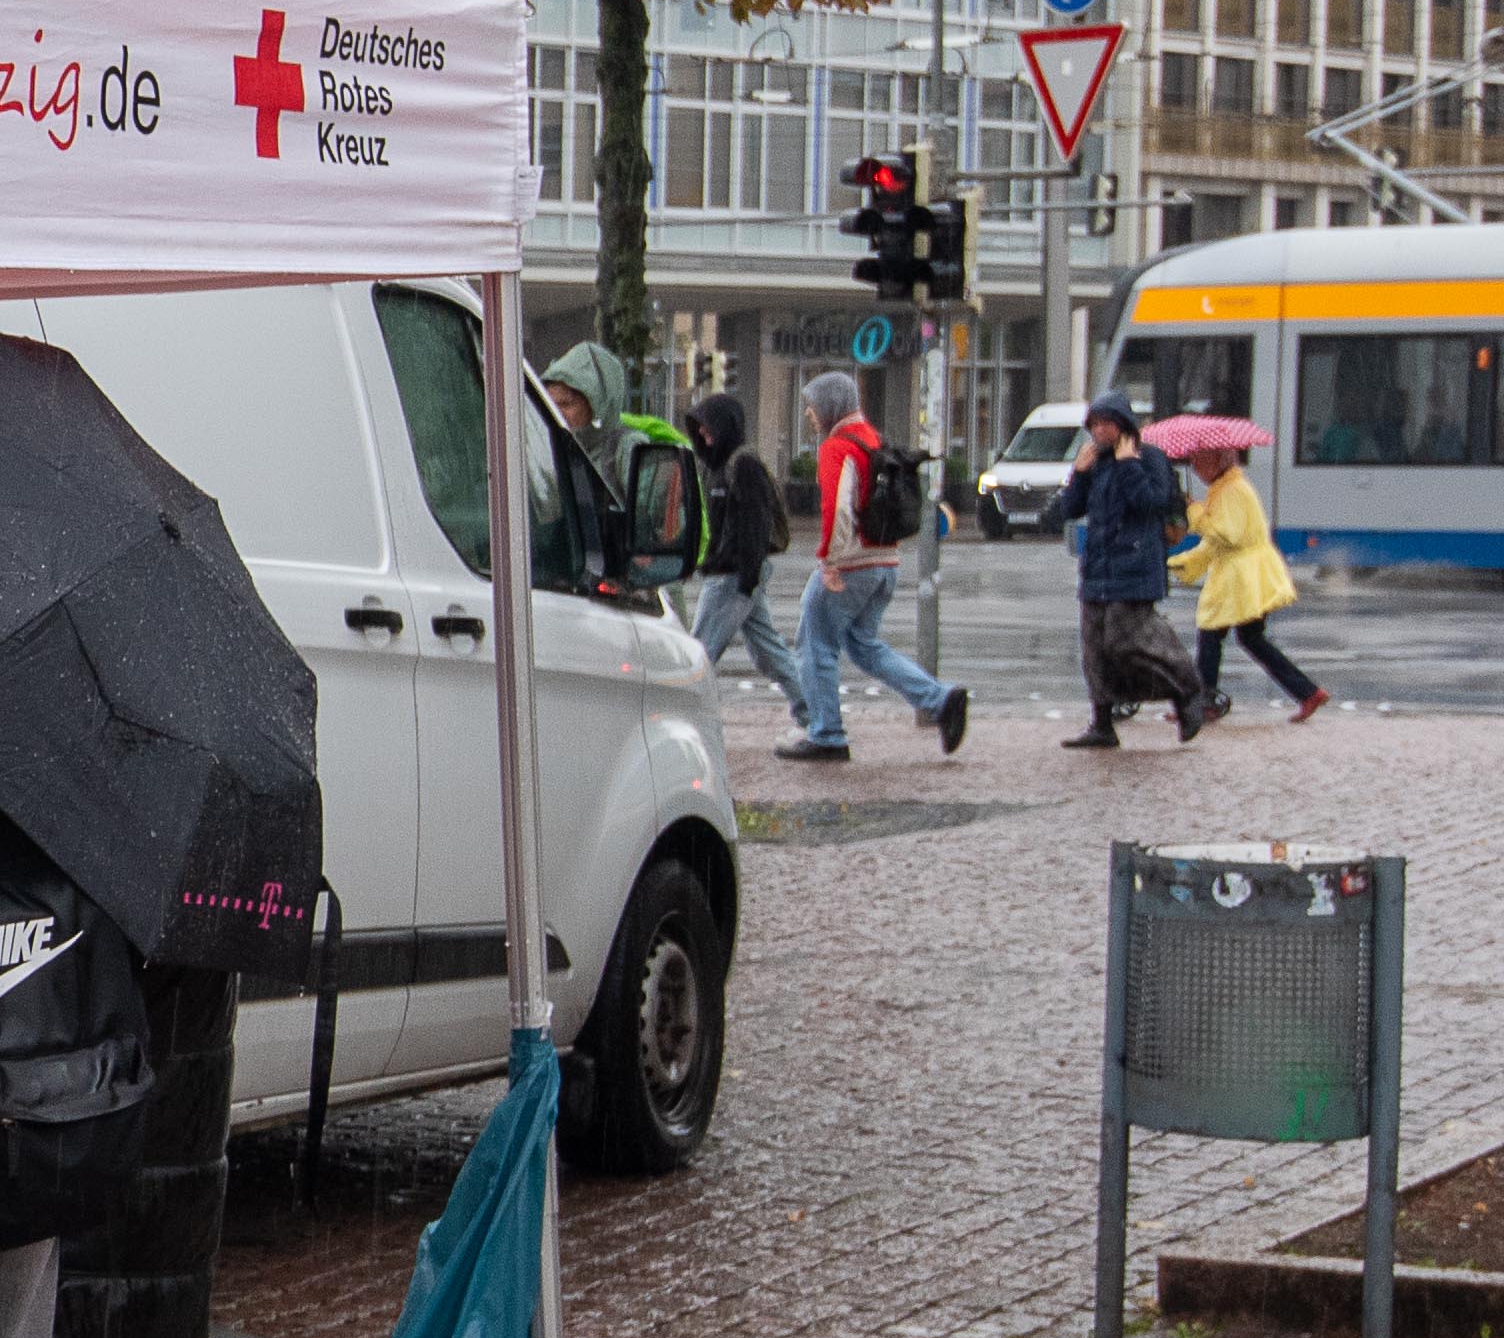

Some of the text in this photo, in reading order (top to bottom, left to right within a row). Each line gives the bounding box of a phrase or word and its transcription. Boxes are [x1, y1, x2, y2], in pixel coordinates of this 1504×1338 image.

[318, 15, 446, 73] Deutsches
[317, 70, 394, 117] Rotes
[316, 120, 390, 168] Kreuz
